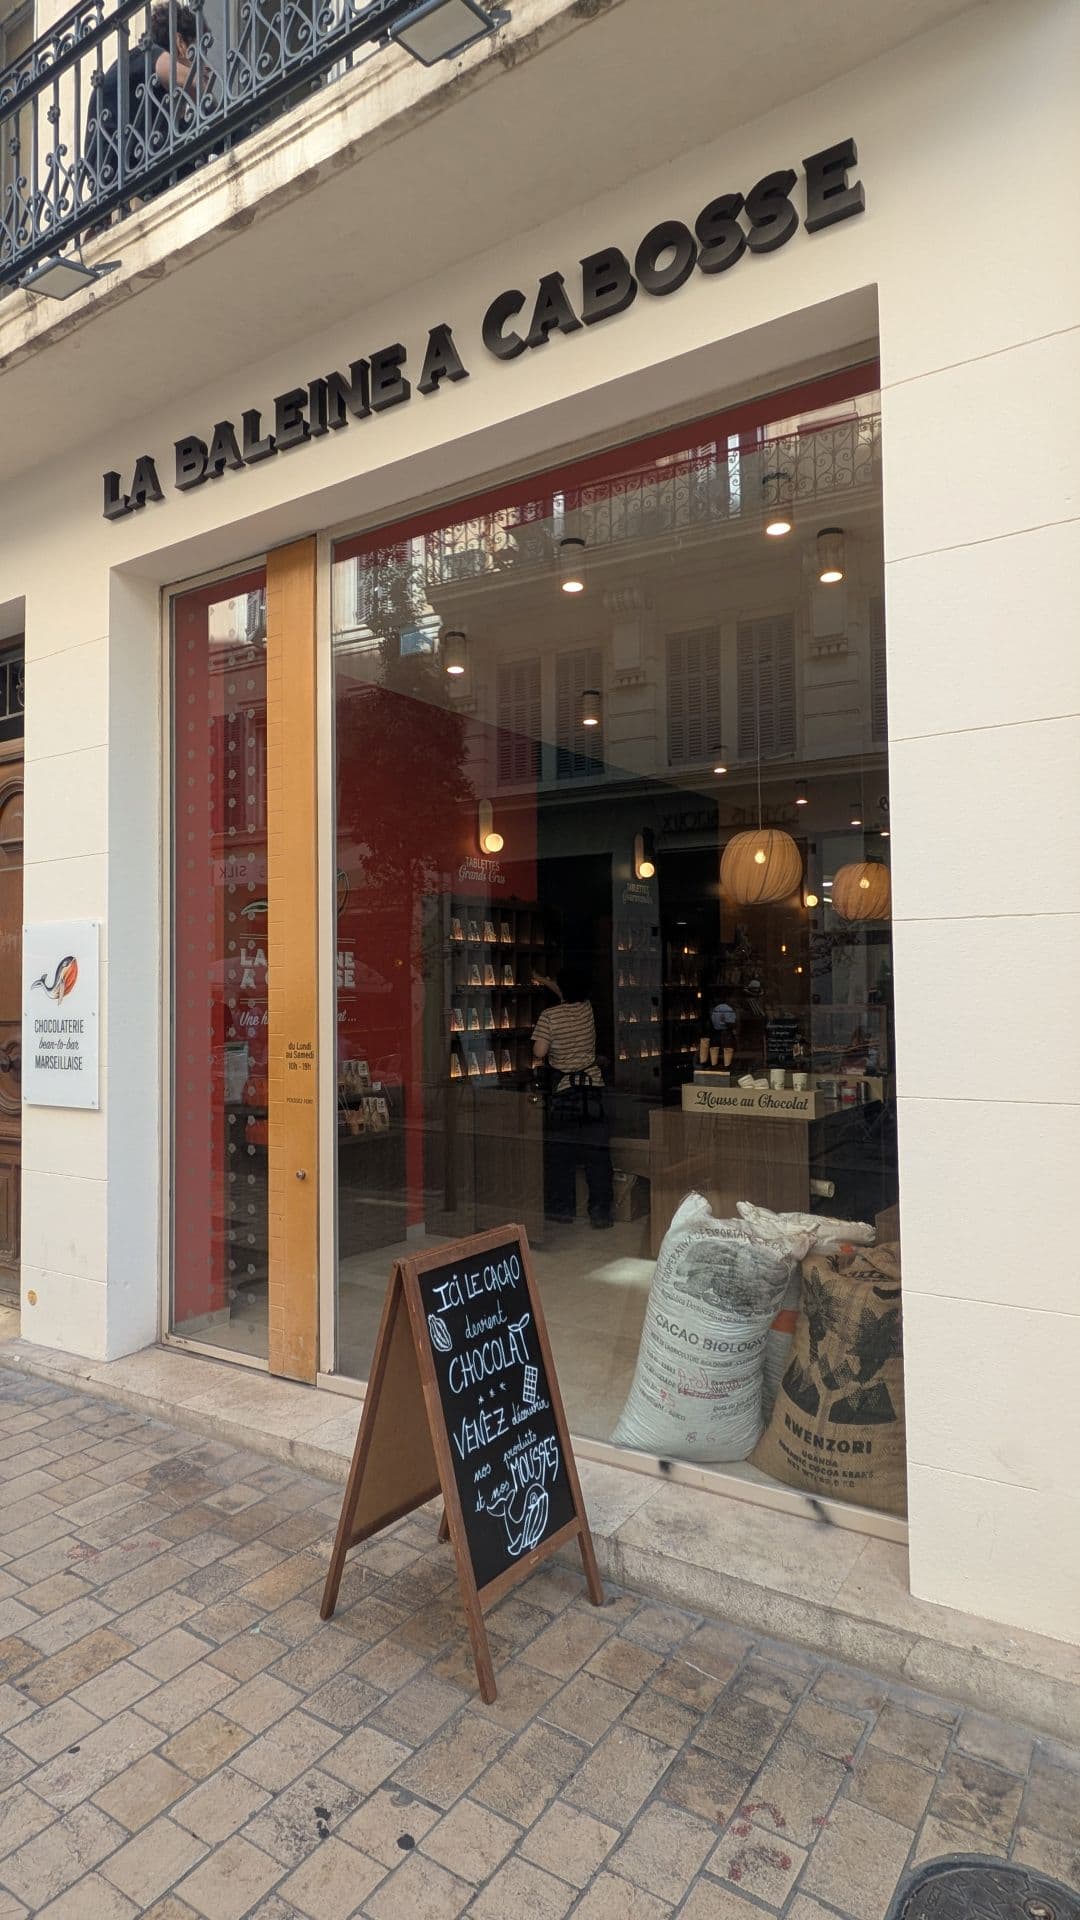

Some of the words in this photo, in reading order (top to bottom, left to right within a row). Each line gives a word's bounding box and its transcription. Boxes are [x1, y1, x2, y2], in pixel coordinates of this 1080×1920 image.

[104, 455, 164, 520] LA
[175, 343, 411, 490] BALEINE
[418, 323, 469, 394] A
[482, 137, 865, 360] CABOSSE
[464, 856, 500, 871] TABLETTES
[240, 948, 268, 967] LA
[240, 968, 257, 989] A
[34, 1018, 84, 1034] CHOCOLATERIE
[239, 1010, 261, 1026] Une
[38, 1037, 80, 1050] bean-to-bar
[288, 1041, 296, 1051] du
[296, 1041, 312, 1051] Lundi
[34, 1055, 83, 1071] MARSEILLAISE
[293, 1050, 315, 1059] Samedi
[695, 1090, 739, 1108] Mousse
[740, 1097, 755, 1107] au
[758, 1093, 809, 1111] Chocolat
[464, 1273, 484, 1299] LE
[483, 1254, 520, 1292] CACAO
[465, 1299, 508, 1339] devient
[655, 1314, 700, 1346] CACAO
[448, 1313, 530, 1394] CHOCOLAT
[453, 1407, 510, 1460] VENEZ
[784, 1411, 873, 1455] RWENZORI
[801, 1449, 838, 1468] UGANDA
[473, 1463, 492, 1484] nos
[475, 1488, 486, 1512] et
[491, 1480, 511, 1501] nos
[510, 1435, 560, 1493] MOUSSES
[808, 1463, 840, 1477] COCOA
